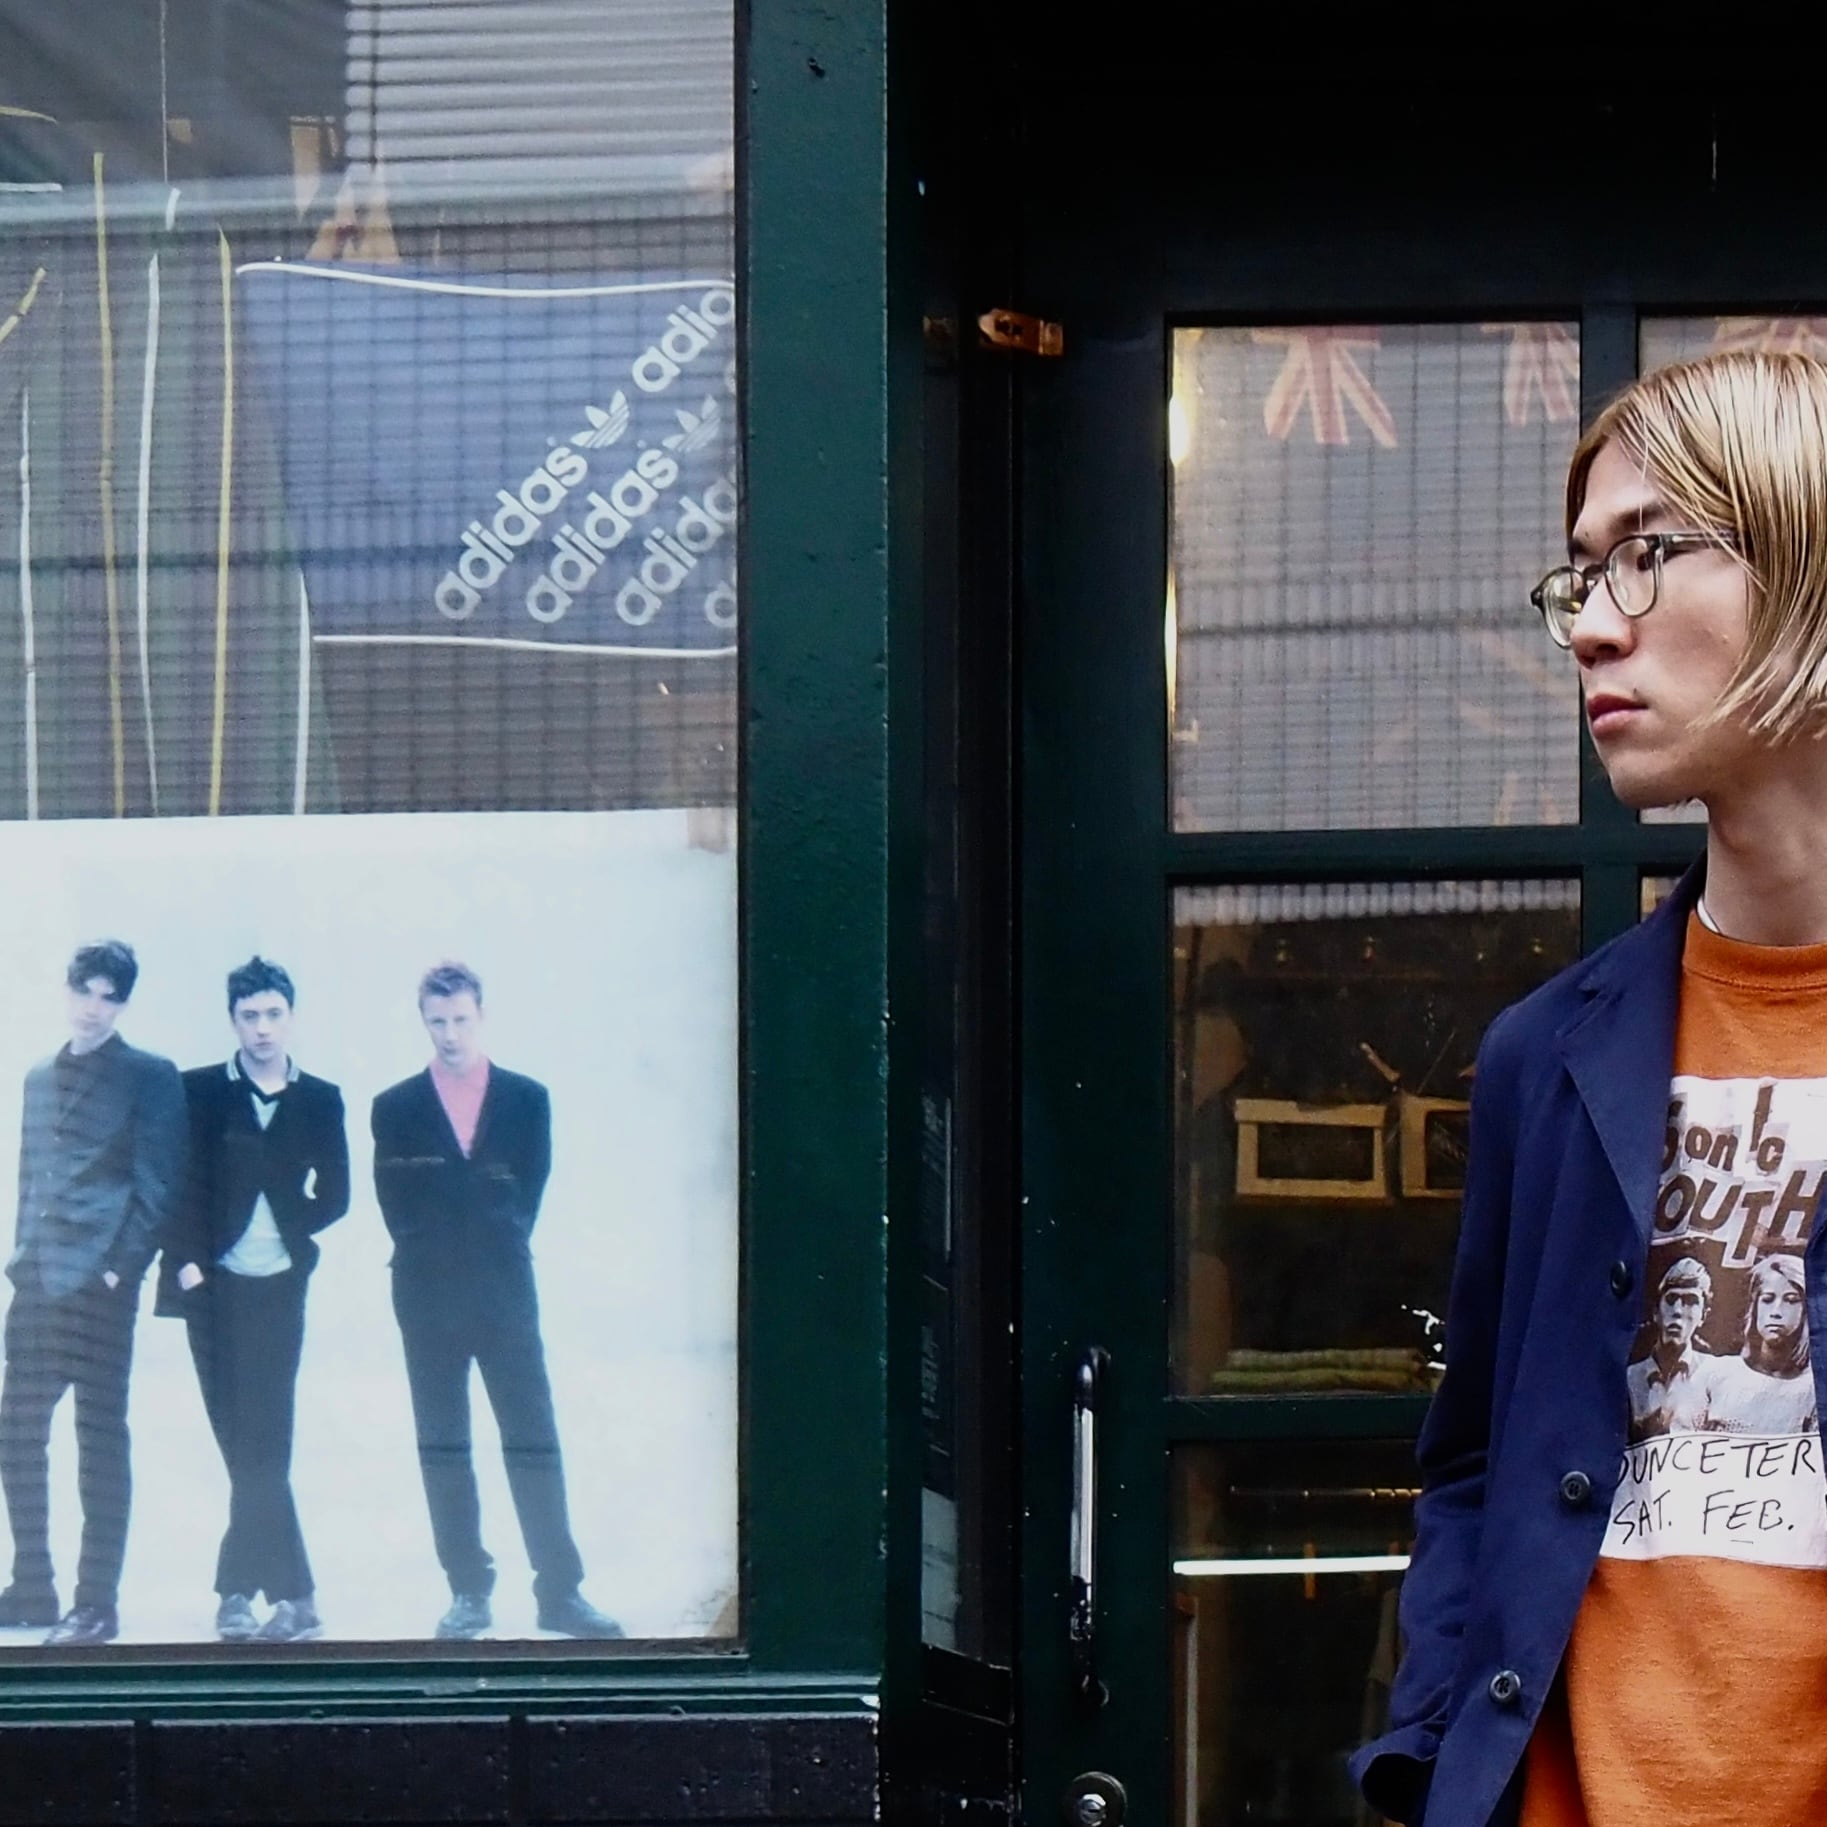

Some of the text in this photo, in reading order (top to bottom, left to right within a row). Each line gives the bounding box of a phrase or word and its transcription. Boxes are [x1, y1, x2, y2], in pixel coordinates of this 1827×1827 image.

[435, 447, 588, 620] adidas
[526, 449, 678, 623] adidas
[1612, 1489, 1673, 1545] SAT.
